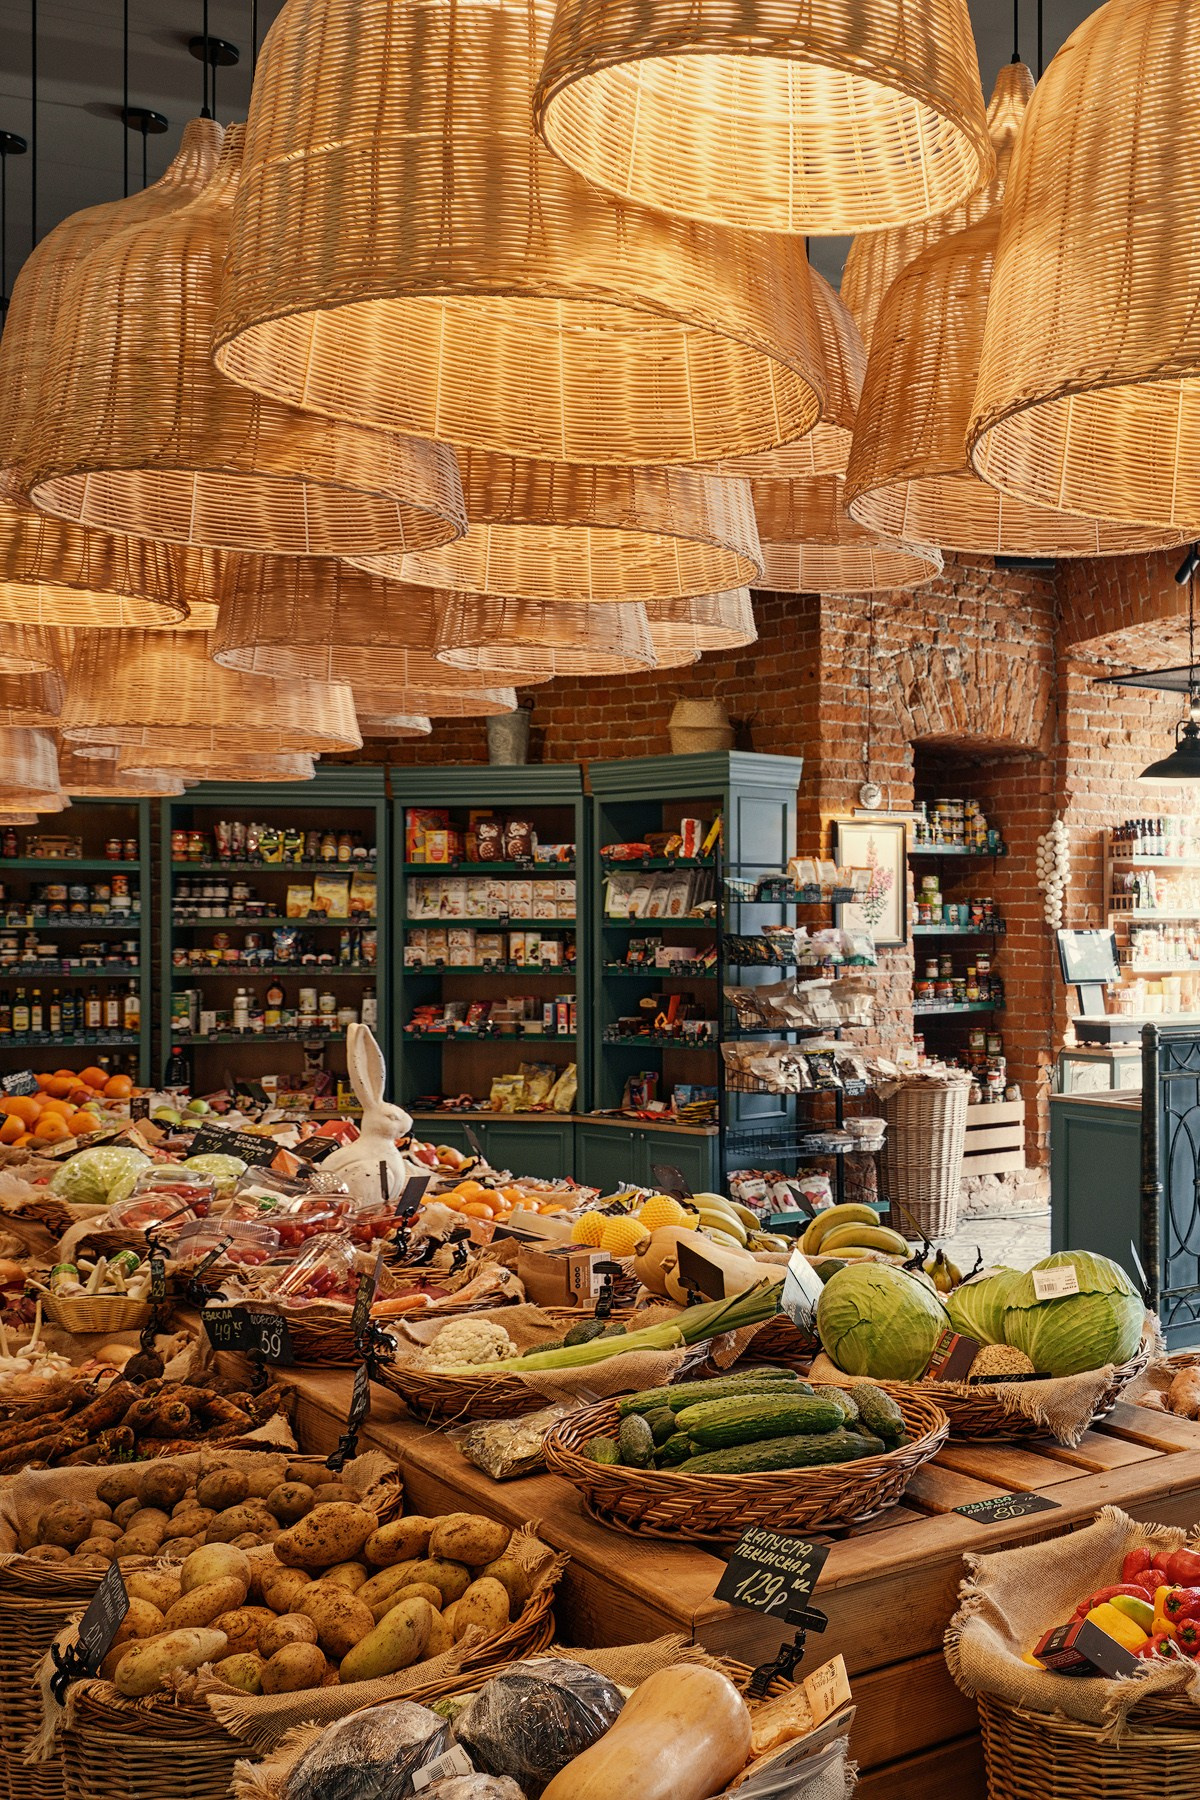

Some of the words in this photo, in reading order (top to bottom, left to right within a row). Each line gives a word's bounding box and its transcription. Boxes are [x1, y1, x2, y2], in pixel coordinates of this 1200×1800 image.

[201, 1310, 233, 1321] СВЕКЛА
[261, 1330, 281, 1358] 59
[957, 1496, 1012, 1512] ТЫКВА
[742, 1527, 813, 1558] КАПУСТА
[734, 1543, 811, 1576] ПЕКИНСКАЯ
